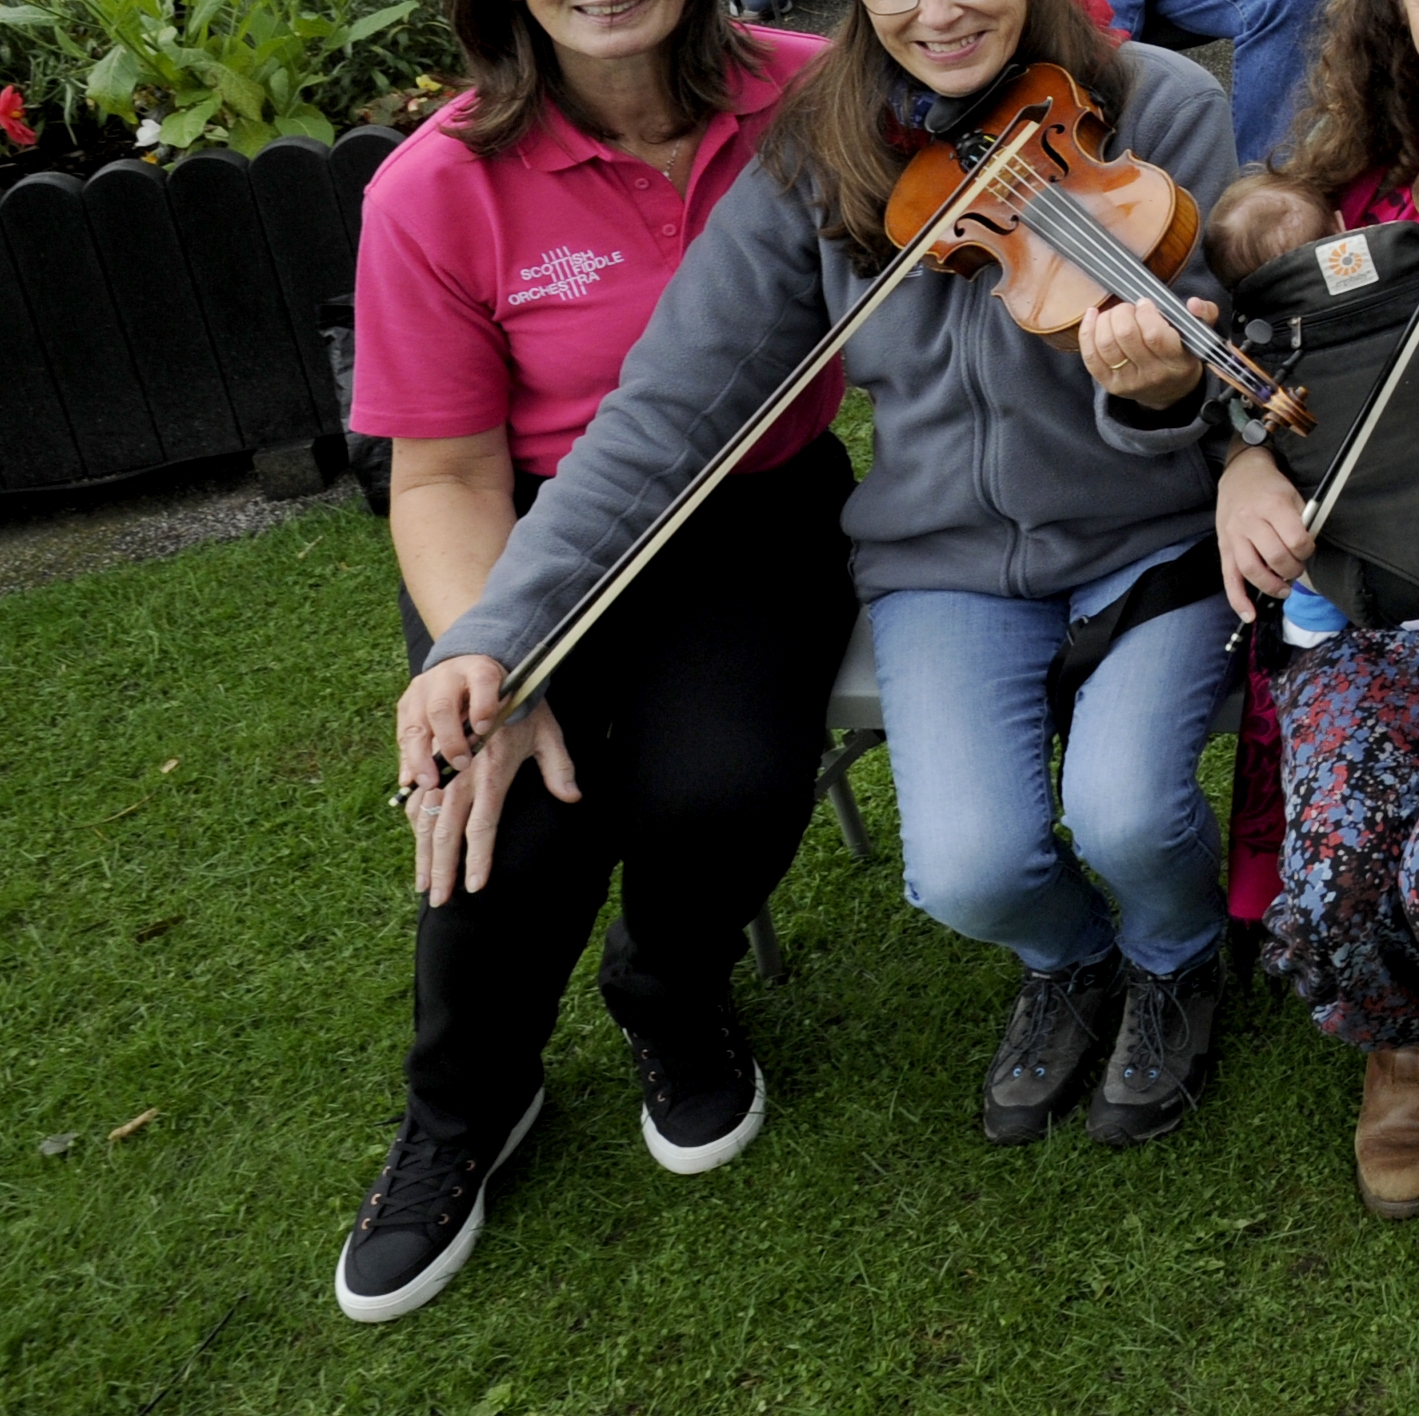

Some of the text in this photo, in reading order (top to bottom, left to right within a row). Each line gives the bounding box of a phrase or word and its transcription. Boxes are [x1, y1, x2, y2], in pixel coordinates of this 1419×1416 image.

[520, 249, 595, 282] SCOTTISH
[571, 250, 625, 276] FIDDLE
[507, 271, 601, 306] ORCHESTRA
